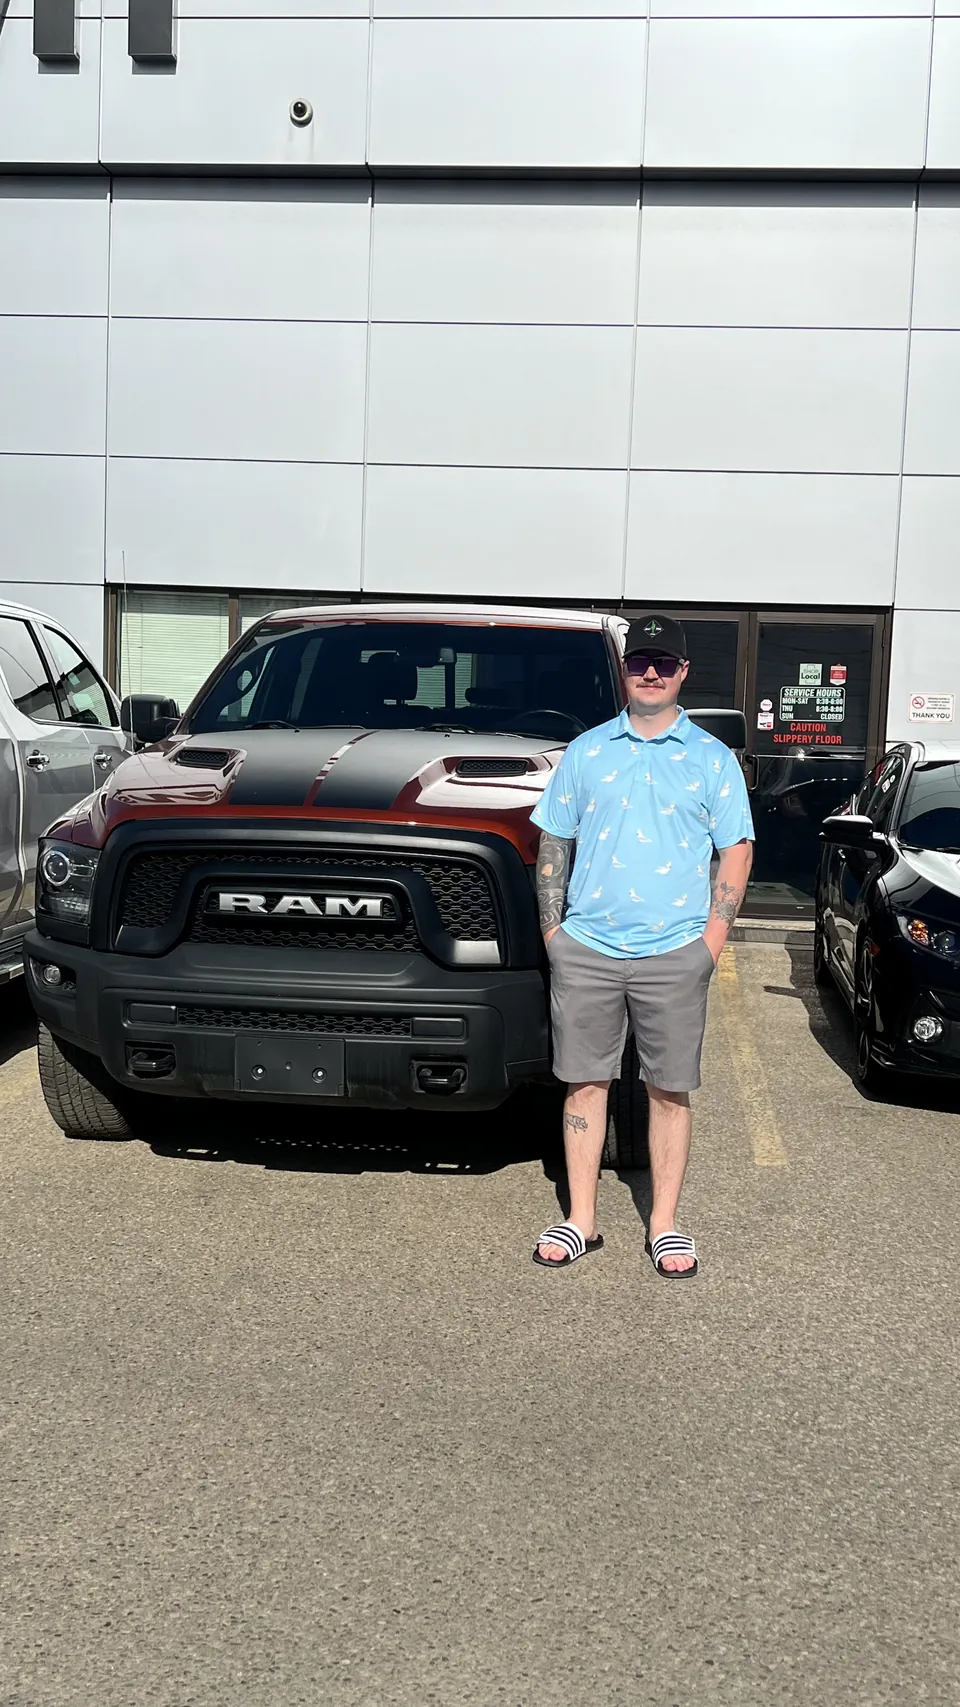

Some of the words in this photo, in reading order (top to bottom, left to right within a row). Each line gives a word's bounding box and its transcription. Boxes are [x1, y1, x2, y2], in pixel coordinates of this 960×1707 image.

[784, 688, 815, 696] SERVICE
[816, 689, 842, 697] HOURS
[790, 722, 827, 732] CAUTION
[773, 734, 813, 743] SLIPPERY
[815, 735, 842, 744] FLOOR
[219, 892, 383, 917] RAM
